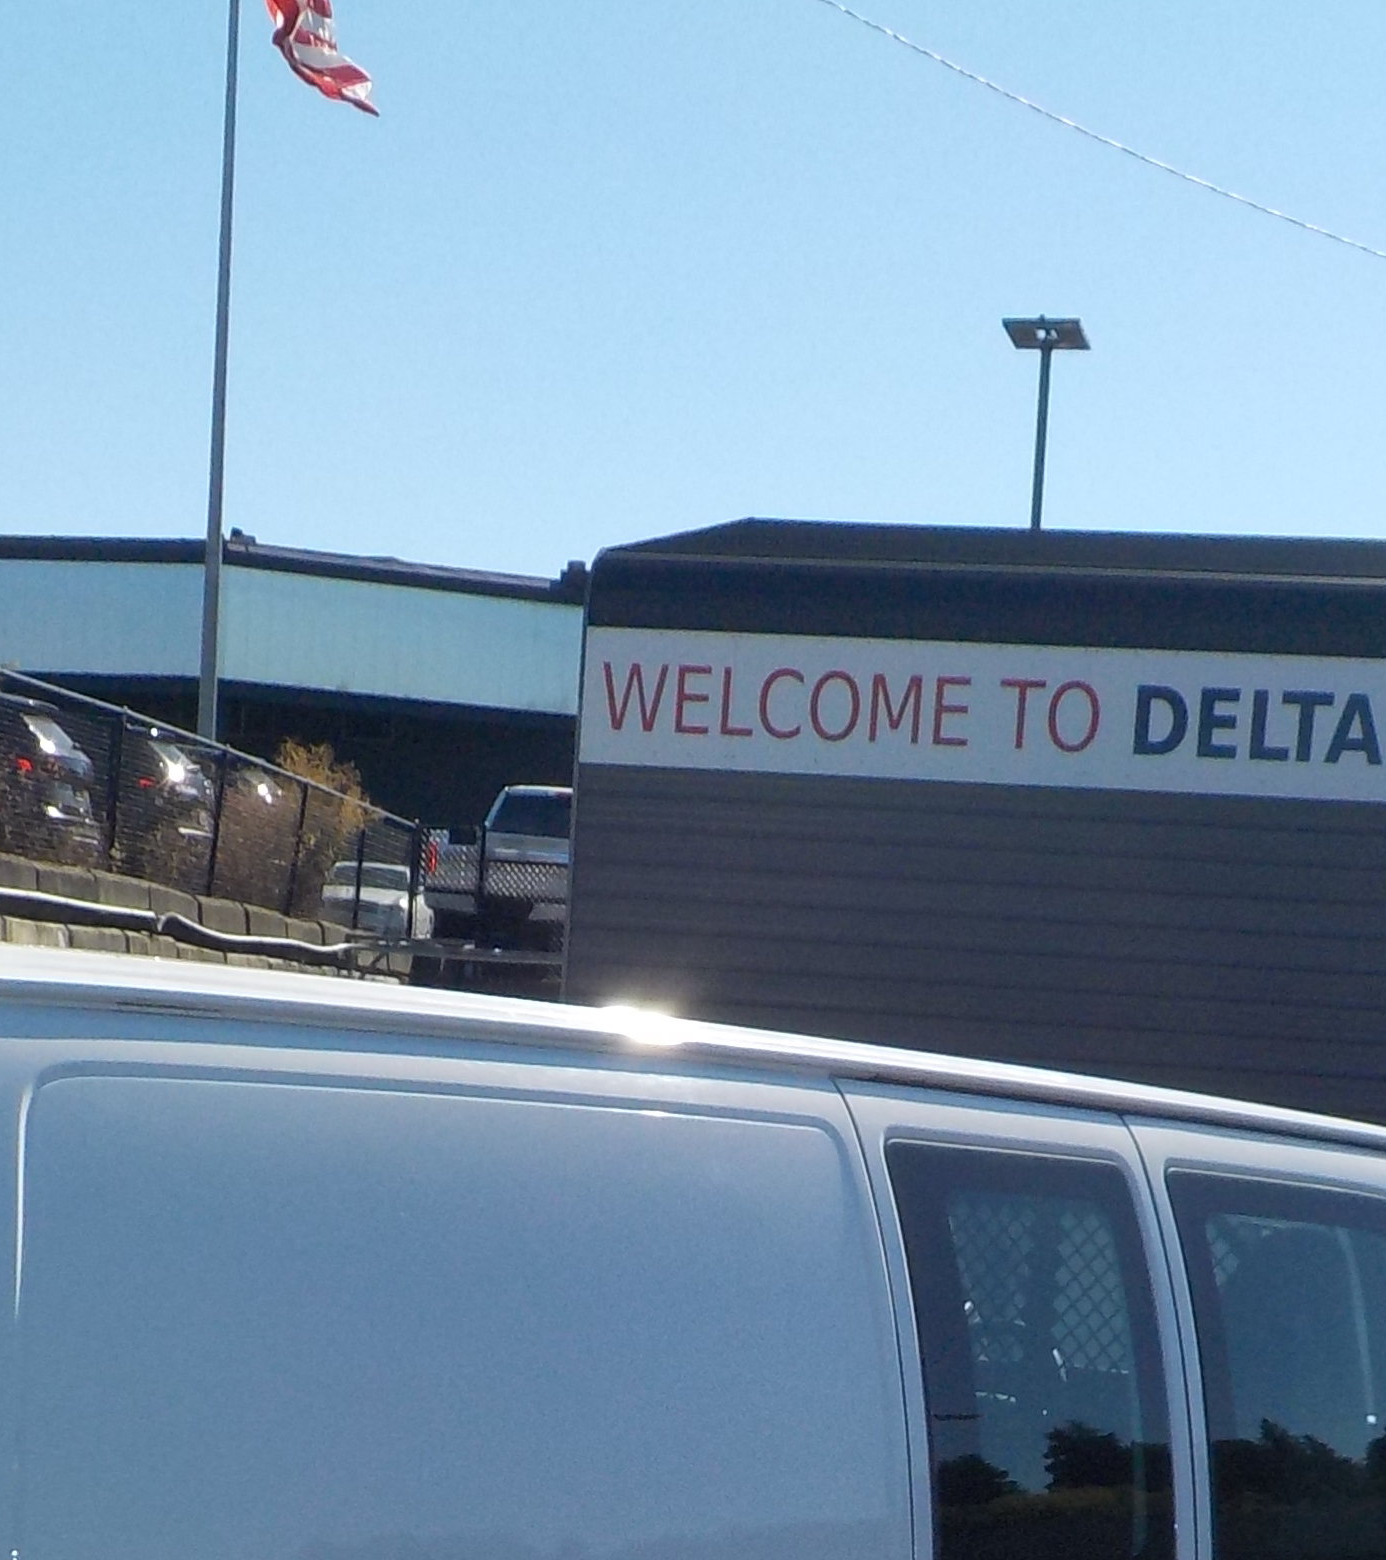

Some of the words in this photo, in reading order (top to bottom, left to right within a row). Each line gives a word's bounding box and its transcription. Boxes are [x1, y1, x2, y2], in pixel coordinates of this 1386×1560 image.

[603, 660, 972, 747] WELCOME
[1000, 677, 1101, 754] TO
[1133, 683, 1383, 766] DELTA
